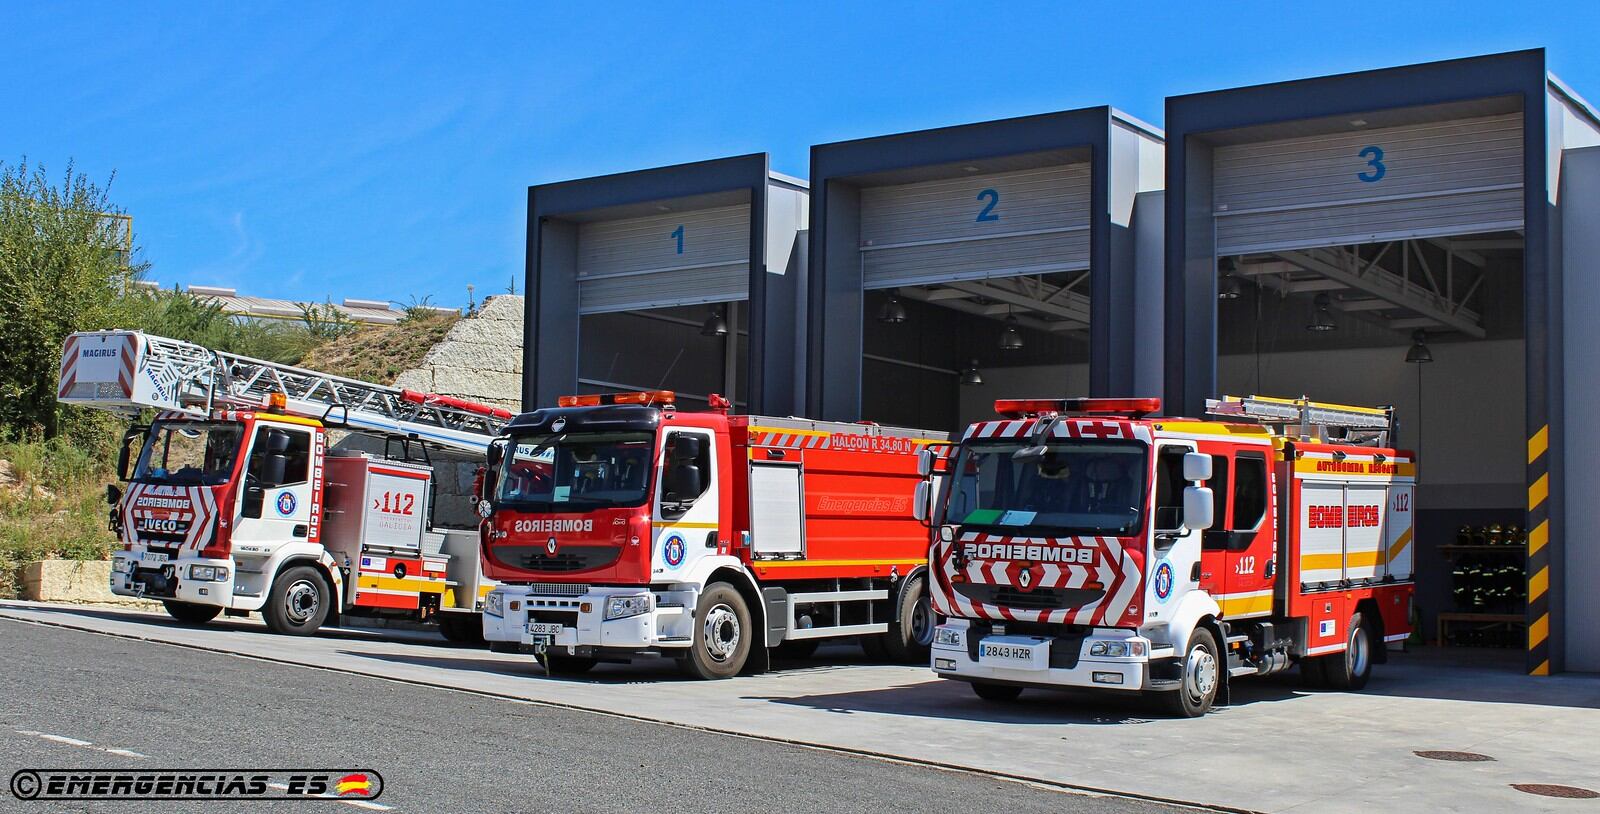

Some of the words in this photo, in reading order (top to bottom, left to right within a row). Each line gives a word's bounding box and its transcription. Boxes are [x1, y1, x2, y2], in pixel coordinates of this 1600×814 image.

[1357, 146, 1386, 182] 3
[975, 188, 1000, 223] 2
[671, 224, 684, 254] 1
[82, 348, 117, 358] MAGIRUS
[146, 367, 169, 402] MAGIRUS
[832, 436, 869, 450] HALCON
[872, 439, 878, 449] R
[880, 439, 903, 451] 34.80
[904, 441, 911, 451] N
[1316, 461, 1364, 473] AUTOBOMBA
[309, 432, 324, 538] BOMBEIROS
[144, 519, 176, 531] IVECO
[530, 624, 546, 633] 4283
[986, 646, 1010, 658] 2843
[1012, 648, 1031, 660] HZR
